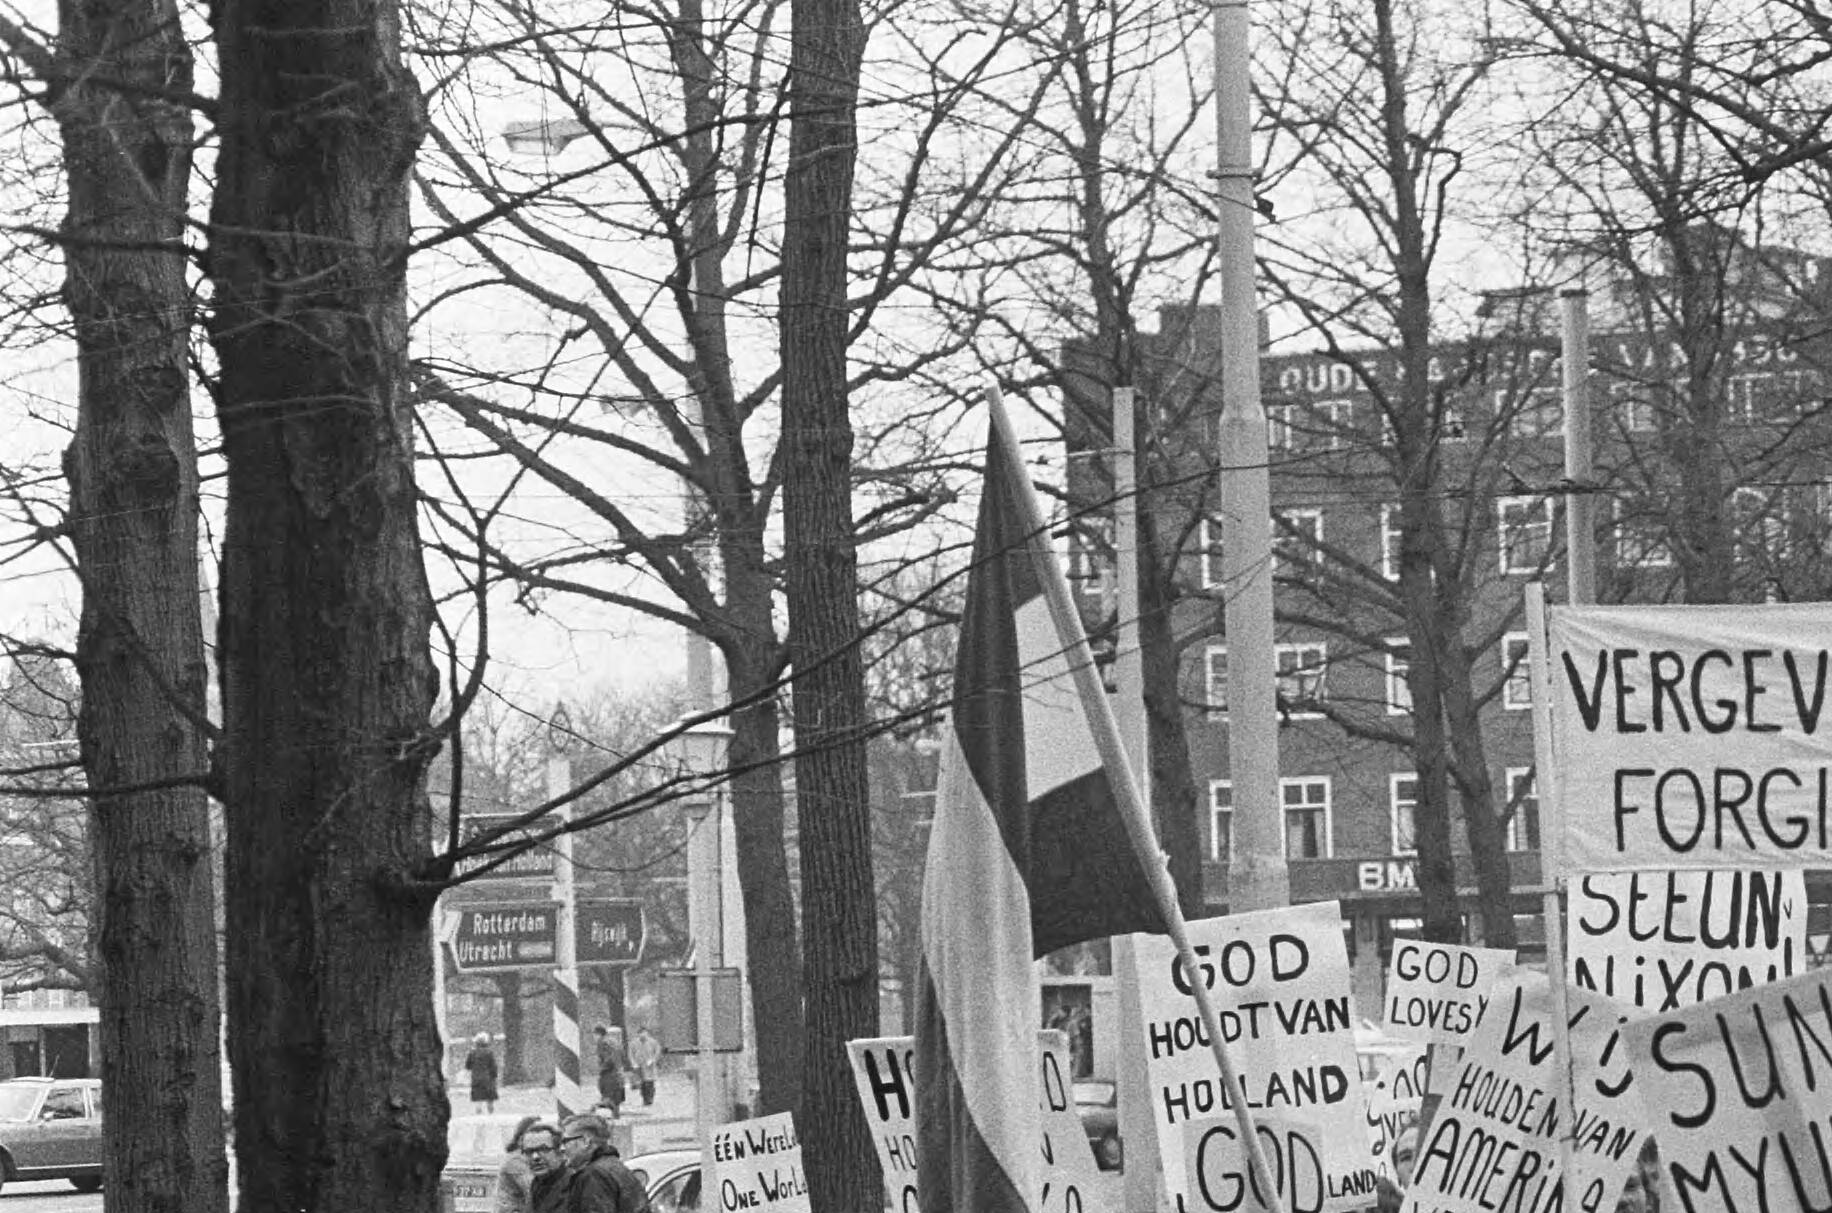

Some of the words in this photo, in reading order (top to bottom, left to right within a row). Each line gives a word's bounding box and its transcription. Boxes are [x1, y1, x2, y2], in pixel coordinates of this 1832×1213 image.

[472, 911, 546, 936] Rotterdam
[458, 940, 513, 963] Utrecht
[1171, 933, 1310, 997] GOD
[1396, 945, 1479, 989] GOD
[1149, 1001, 1269, 1059] HOUDT
[1274, 996, 1351, 1035] VAN
[1390, 996, 1473, 1034] LOVES
[1162, 1065, 1350, 1124] HOLLAND
[1451, 1061, 1560, 1139] HOUDEN
[1572, 1108, 1637, 1161] VAN
